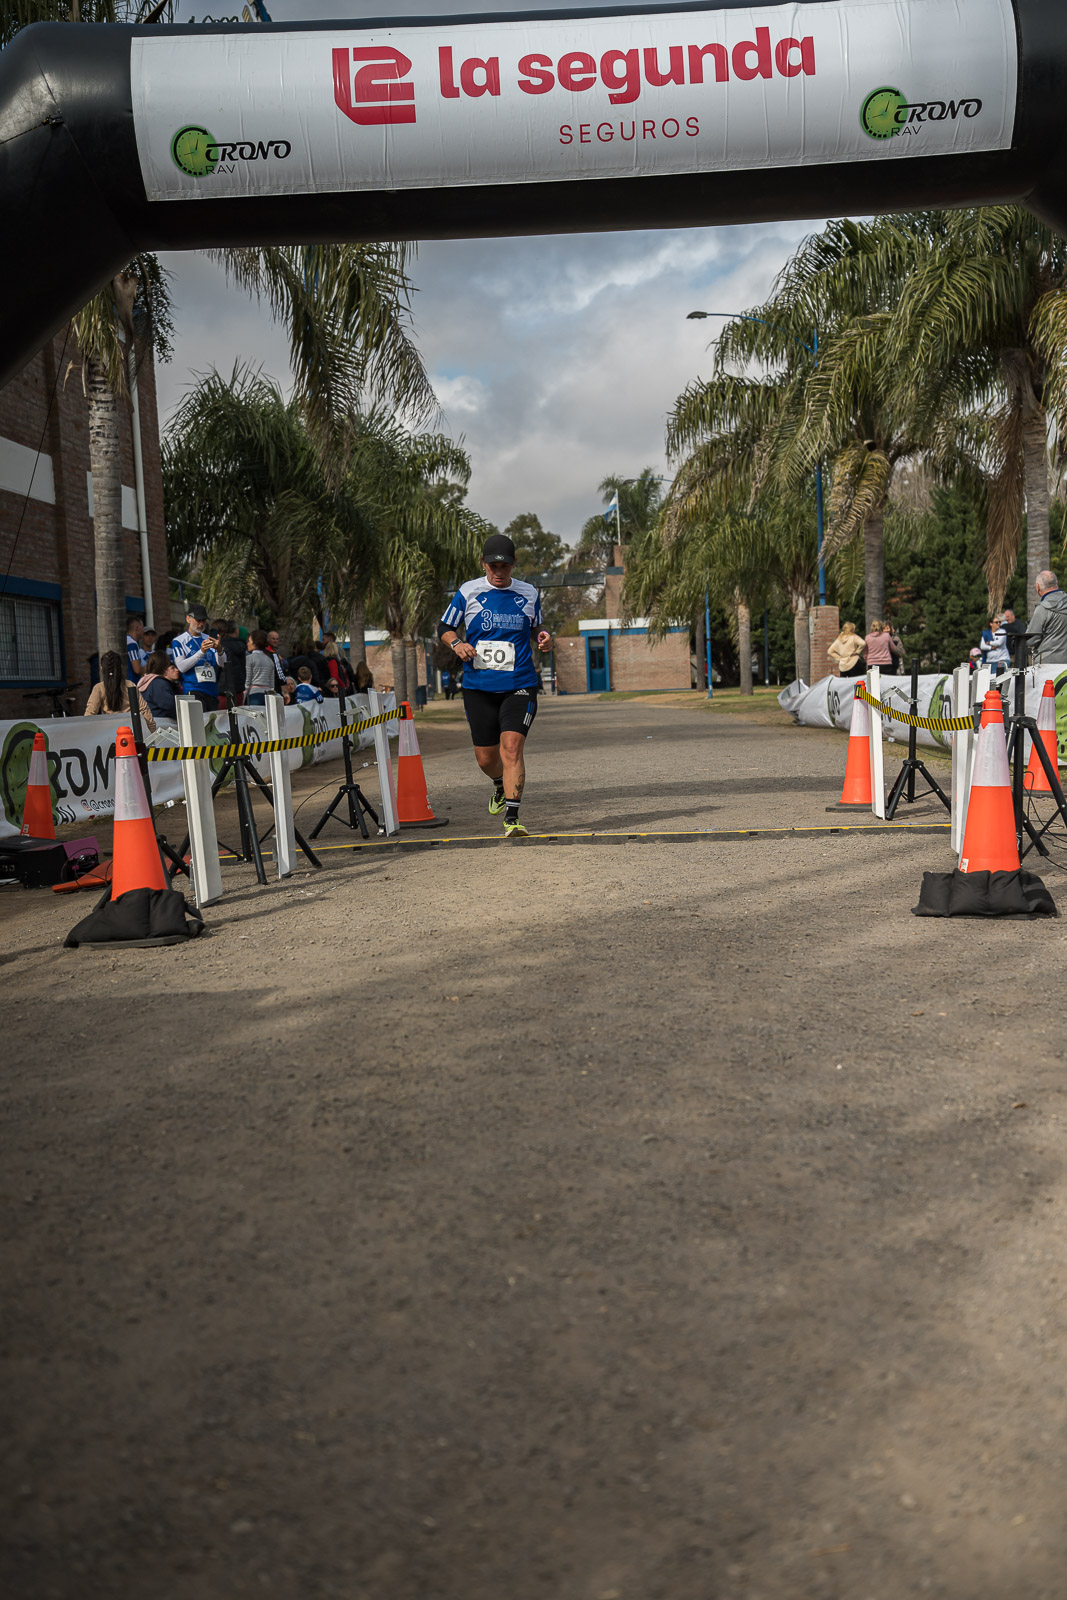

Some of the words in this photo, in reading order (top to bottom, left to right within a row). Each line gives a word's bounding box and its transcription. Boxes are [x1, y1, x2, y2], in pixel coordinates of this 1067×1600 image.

[438, 46, 501, 99] la
[517, 26, 816, 105] segunda
[893, 98, 982, 124] CRONO
[559, 116, 701, 145] SEGUROS
[890, 125, 922, 137] RAV
[205, 140, 292, 162] CRONO
[205, 164, 236, 175] RAV
[481, 609, 492, 631] 3
[482, 649, 505, 663] 50
